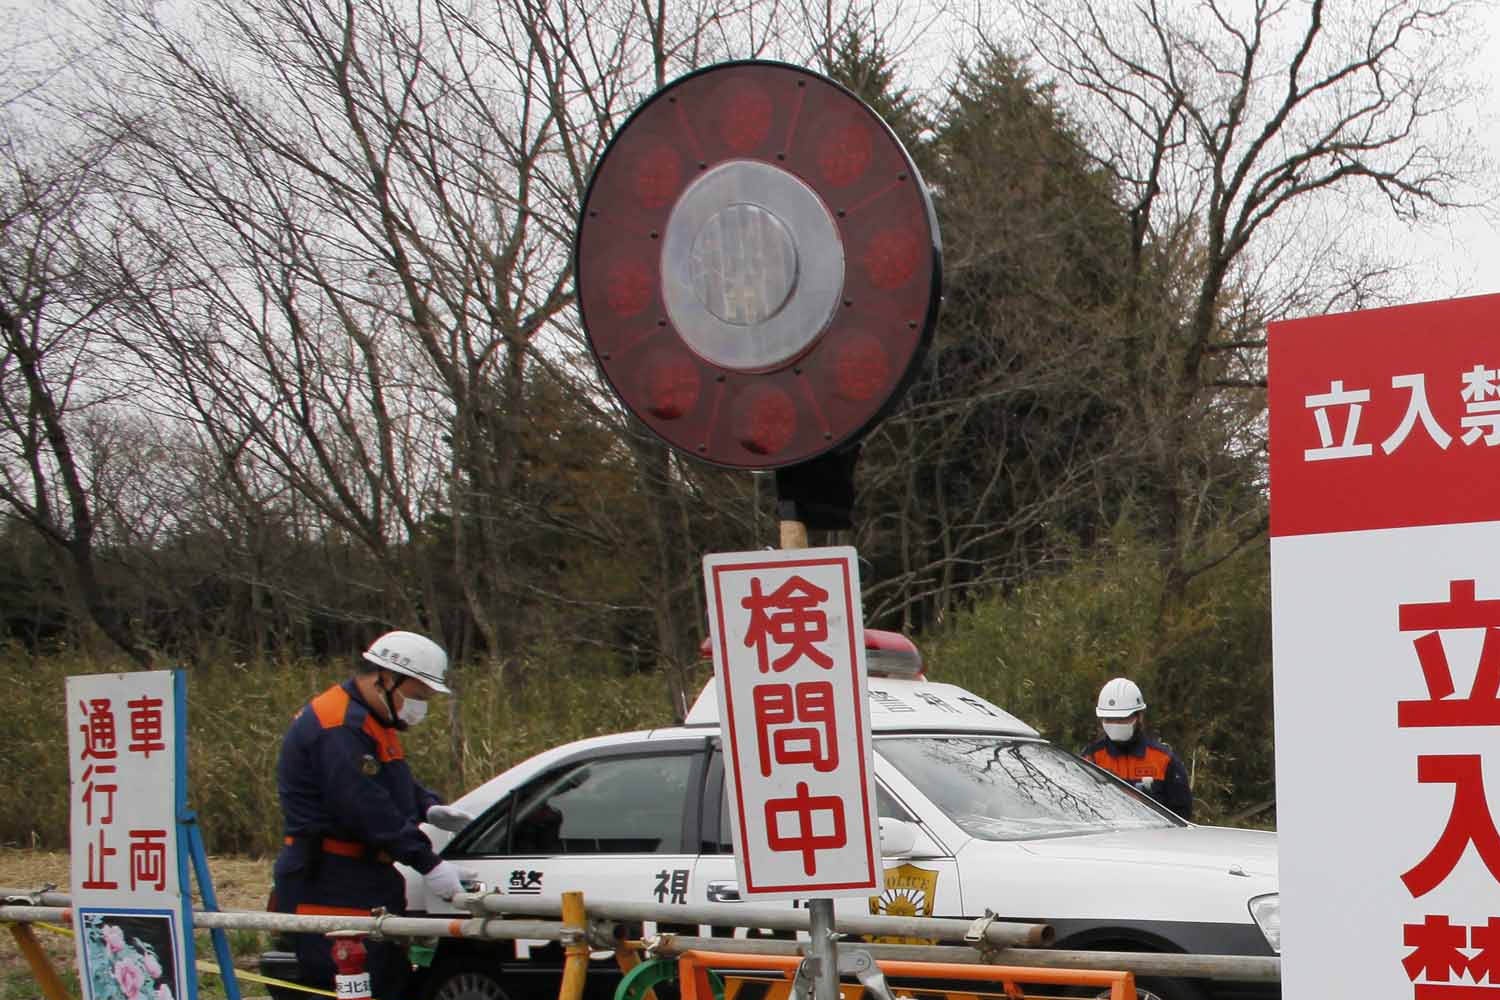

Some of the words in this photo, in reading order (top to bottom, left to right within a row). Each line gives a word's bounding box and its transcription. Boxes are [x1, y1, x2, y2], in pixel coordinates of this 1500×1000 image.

[80, 698, 118, 890] 通行止
[127, 694, 167, 892] 車両
[741, 575, 848, 877] 検問中
